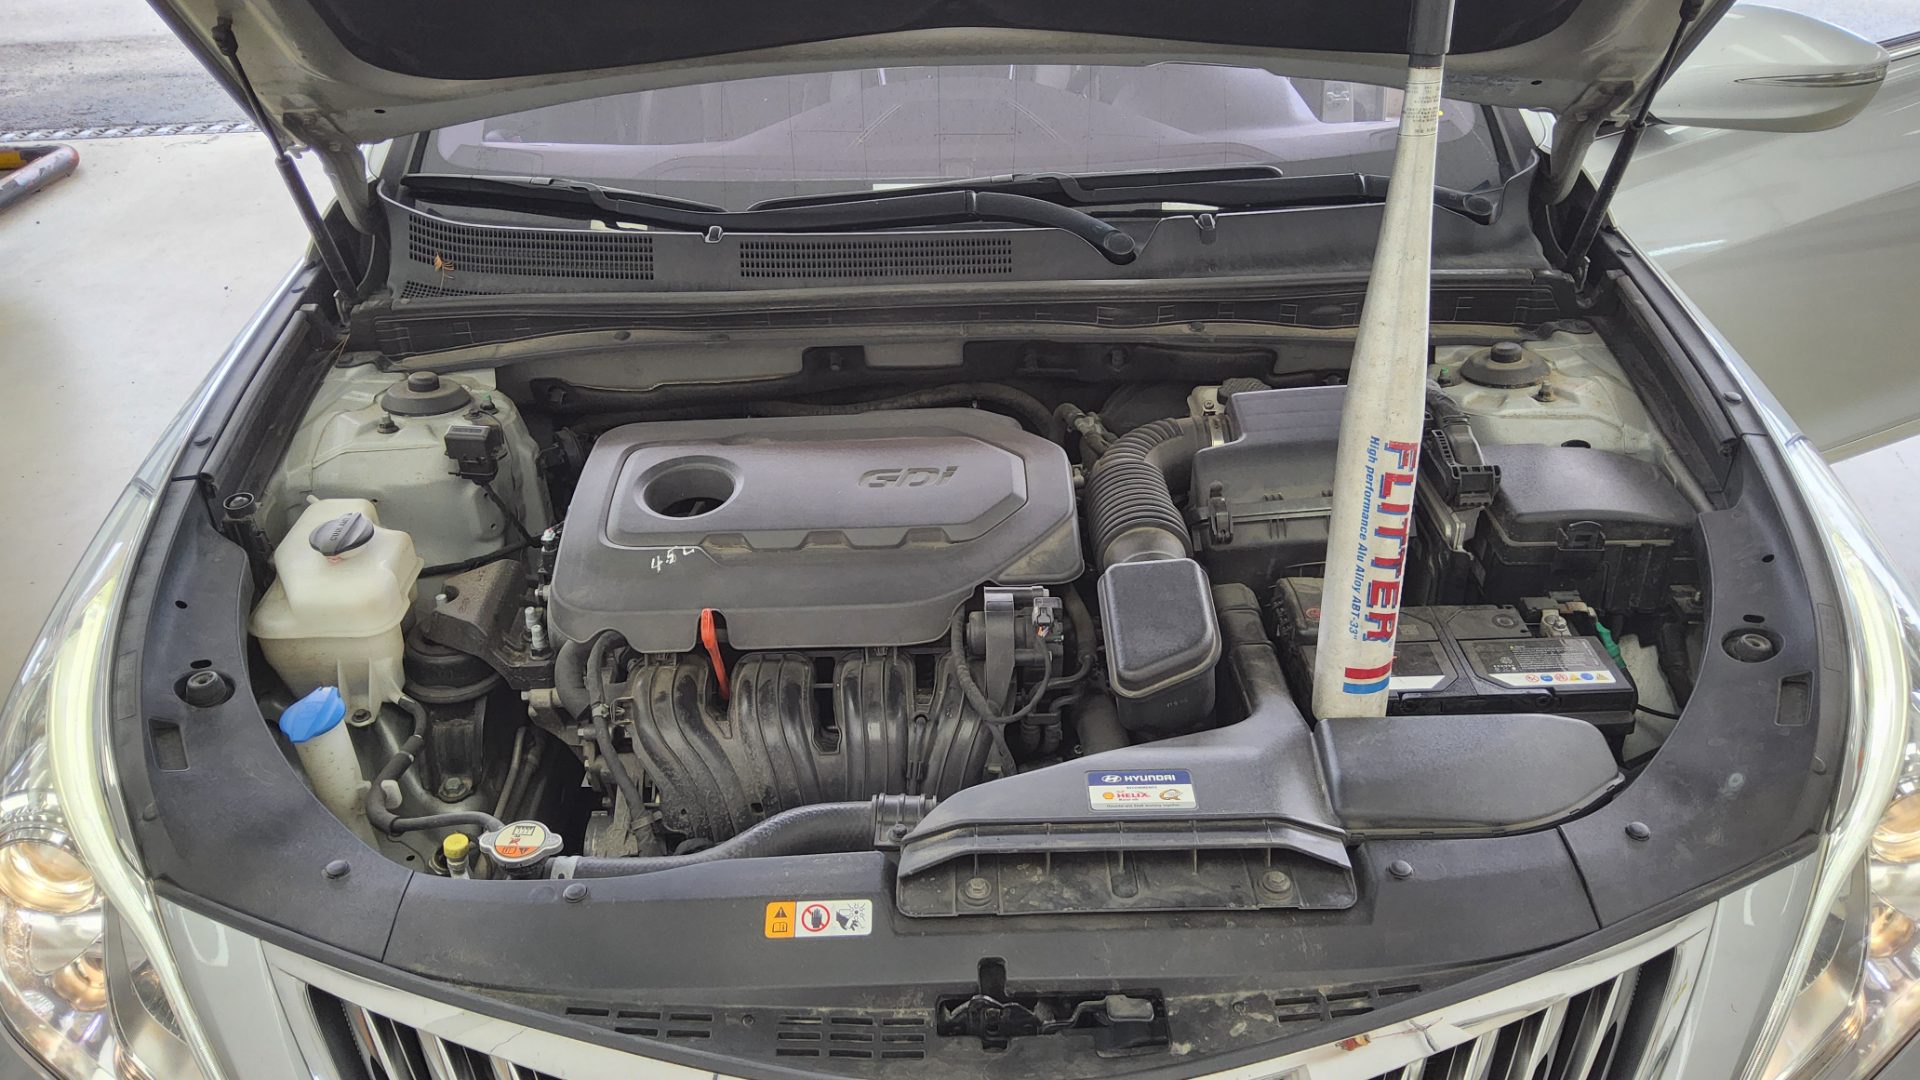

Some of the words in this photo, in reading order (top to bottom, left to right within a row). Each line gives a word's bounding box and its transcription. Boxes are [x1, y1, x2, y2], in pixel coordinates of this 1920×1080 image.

[1367, 436, 1380, 464] High
[1359, 465, 1375, 540] performance
[1356, 543, 1368, 563] Alu
[1362, 440, 1418, 642] FLITTER
[1352, 564, 1365, 594] Alloy
[1125, 774, 1176, 782] HYUNDAI
